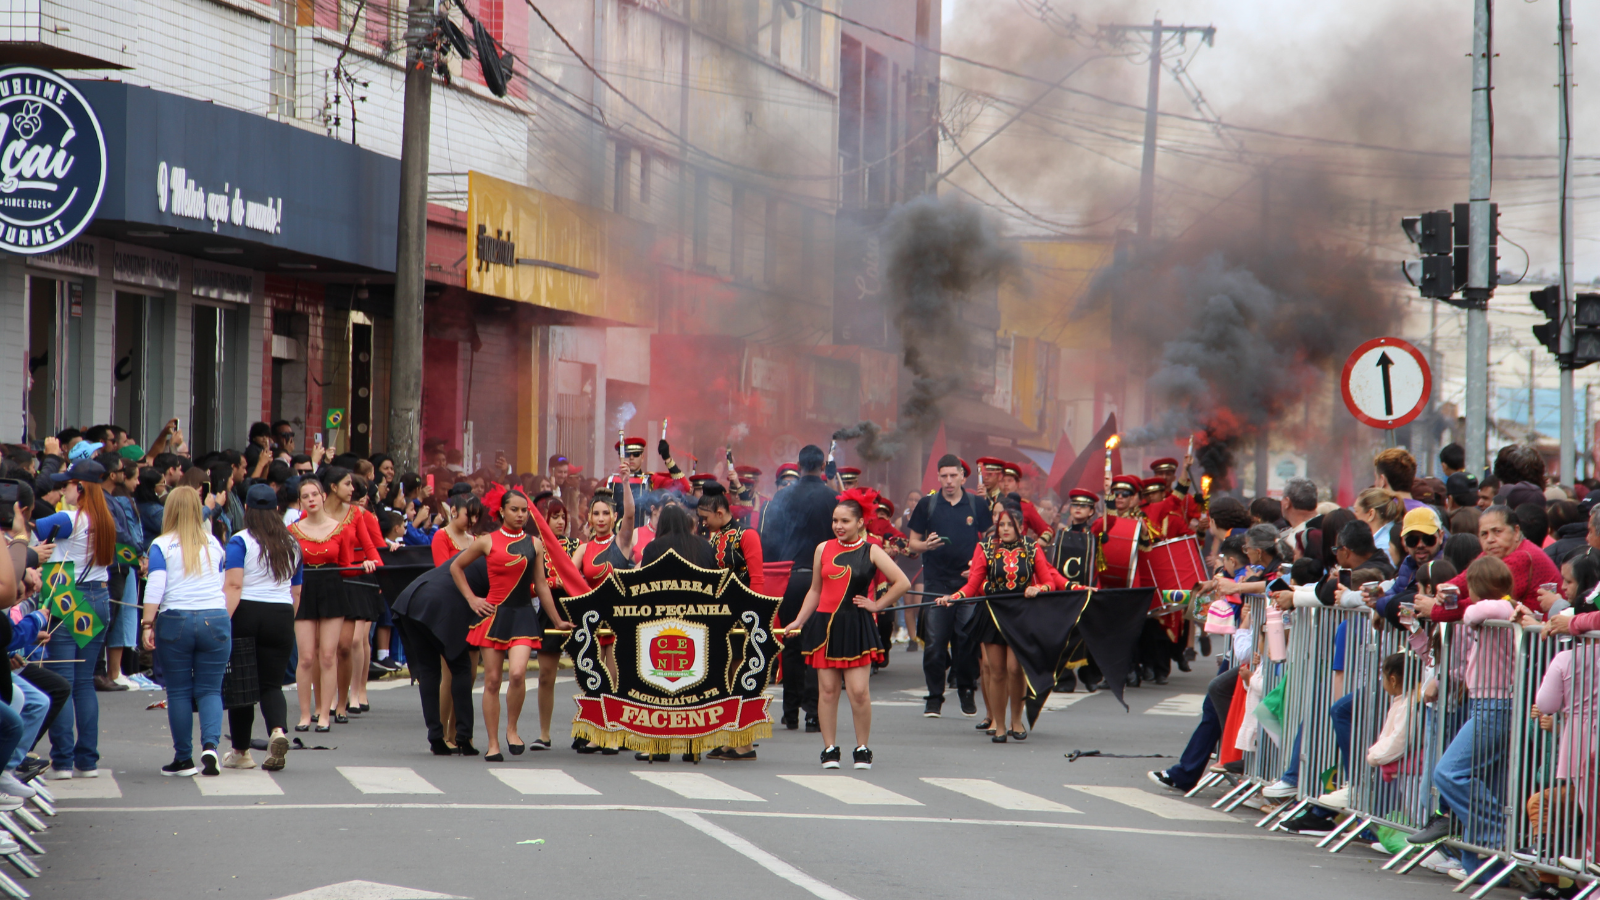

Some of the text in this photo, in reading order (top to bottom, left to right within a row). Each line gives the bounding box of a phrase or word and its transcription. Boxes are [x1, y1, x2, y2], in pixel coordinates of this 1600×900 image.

[4, 197, 46, 209] SINCE 2025
[157, 161, 168, 212] O
[170, 166, 206, 220] Melhor
[231, 188, 245, 226] do
[246, 197, 282, 234] mundo!
[774, 440, 800, 458] 30
[1063, 557, 1081, 578] C
[629, 579, 714, 597] FANFARRA
[612, 604, 732, 619] NILO PEÇANHA
[657, 638, 688, 649] C E
[657, 659, 689, 669] N P
[619, 705, 724, 728] FACENP
